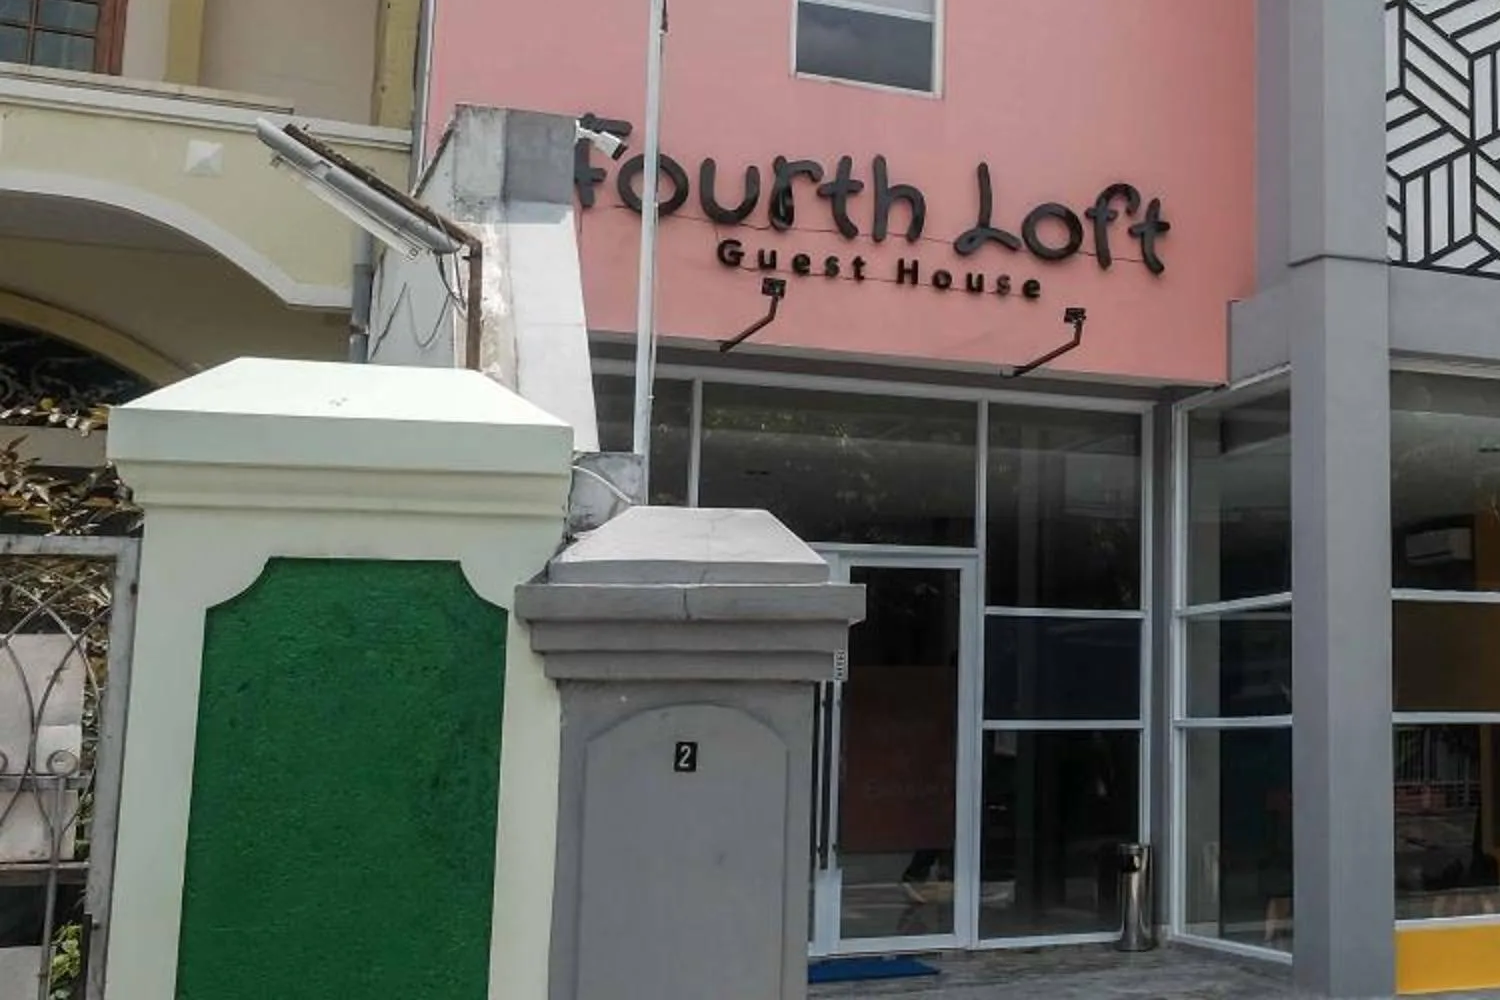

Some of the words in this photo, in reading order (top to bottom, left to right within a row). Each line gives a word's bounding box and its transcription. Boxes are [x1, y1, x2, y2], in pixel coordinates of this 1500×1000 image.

[573, 112, 927, 243] Fourth
[953, 162, 1172, 276] Loft
[716, 237, 866, 283] Guest
[895, 257, 1042, 300] House
[679, 744, 692, 767] 2
